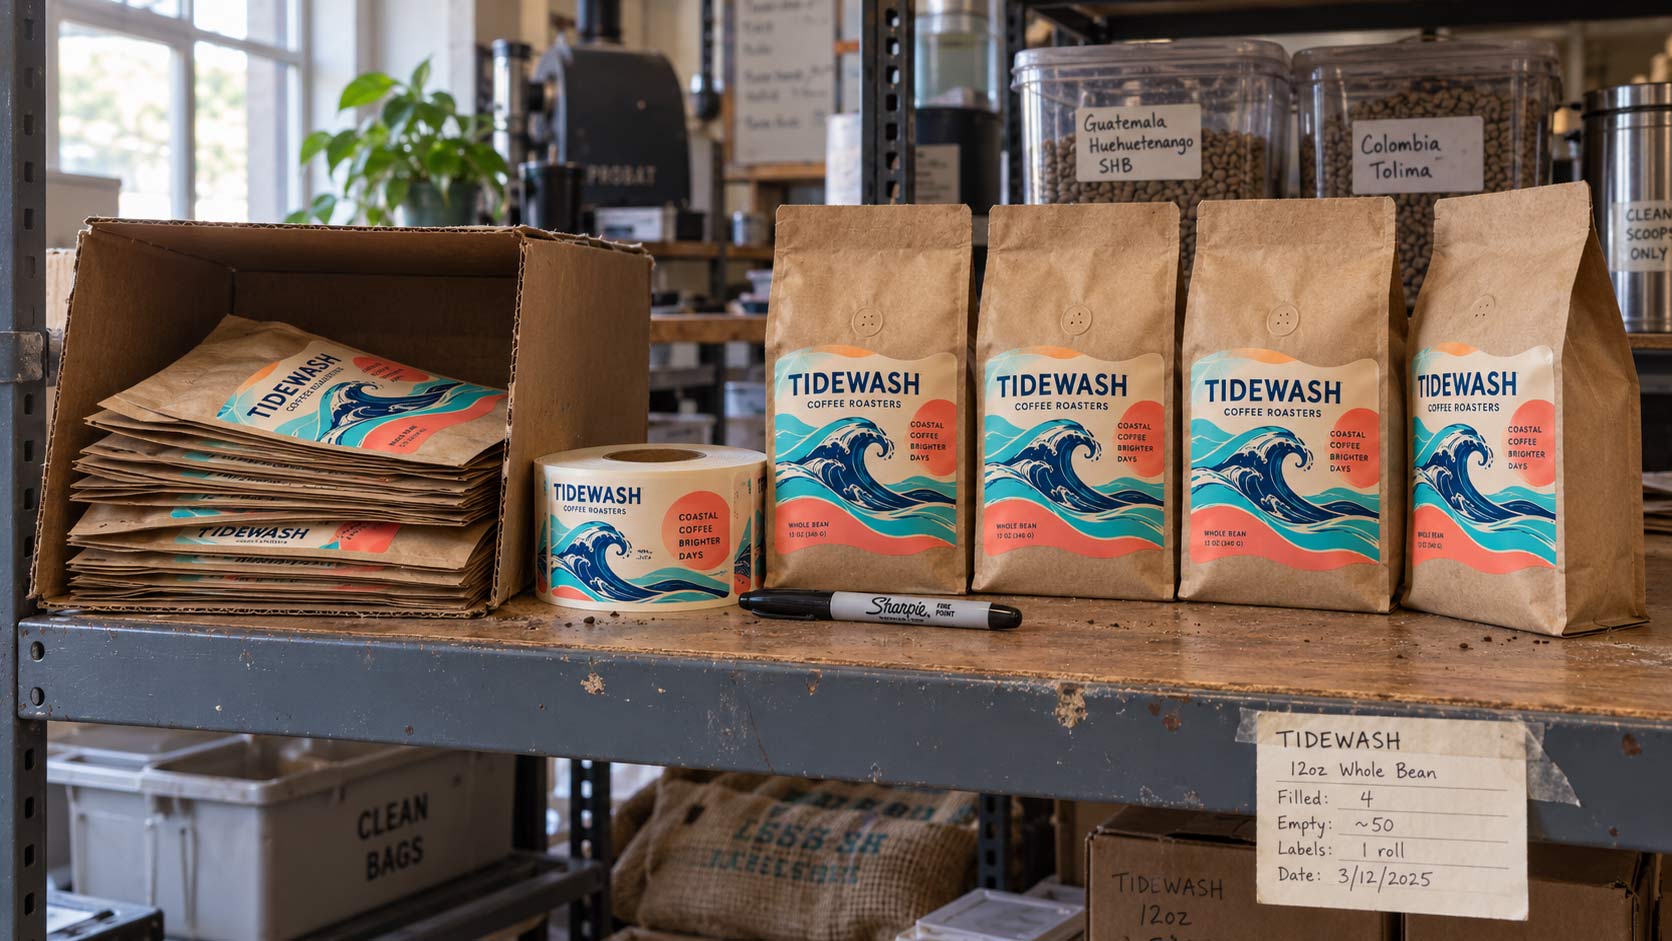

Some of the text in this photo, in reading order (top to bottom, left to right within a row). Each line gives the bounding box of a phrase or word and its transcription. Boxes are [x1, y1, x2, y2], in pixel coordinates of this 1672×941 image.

[1084, 112, 1167, 133] Guatemala
[1089, 135, 1194, 155] Huehuetenango
[1361, 133, 1441, 155] Colombia
[1099, 157, 1133, 174] SHB
[1369, 161, 1432, 180] Tolima
[1626, 208, 1672, 222] CLEAN
[1630, 246, 1668, 261] ONLY
[247, 352, 343, 419] TIDEWASH
[788, 371, 920, 396] TIDEWASH
[996, 373, 1127, 398] TIDEWASH
[1418, 371, 1517, 398] TIDEWASH
[1204, 379, 1341, 404] TIDEWASH
[807, 399, 901, 409] COFFEE ROASTERS
[1015, 402, 1109, 411] COFFEE ROASTERS
[1428, 402, 1500, 412] COFFEE ROASTERS
[1224, 407, 1322, 418] COFFEE ROASTERS
[910, 421, 944, 429] COASTAL
[1117, 422, 1152, 431] COASTAL
[1508, 425, 1542, 433] COASTAL
[910, 432, 939, 440] COFFEE
[1117, 433, 1146, 441] COFFEE
[1330, 430, 1366, 439] COASTAL
[910, 443, 946, 451] BRIGHTER
[1330, 442, 1360, 450] COFFEE
[1508, 438, 1537, 446] COFFEE
[910, 454, 930, 462] DAYS
[1330, 453, 1369, 462] BRIGHTER
[1508, 450, 1546, 459] BRIGHTER
[1330, 464, 1351, 472] DAYS
[553, 483, 641, 505] TIDEWASH
[563, 505, 627, 515] COFFEE ROASTERS
[679, 511, 718, 521] COASTAL
[197, 526, 310, 540] TIDEWASH
[679, 524, 713, 534] COFFEE
[679, 537, 721, 547] BRIGHTER
[679, 551, 703, 560] DAYS
[935, 609, 955, 617] POINT
[1275, 730, 1400, 750] TIDEWASH
[1291, 761, 1437, 779] 12oz Whole Bean
[1277, 789, 1373, 808] Filled: 4
[358, 792, 428, 839] CLEAN
[1277, 816, 1394, 839] Empty: ~50
[1278, 841, 1405, 858] Labels: 1 roll
[367, 836, 424, 881] BAGS
[1278, 864, 1433, 893] Date: 3/12/2025
[1111, 872, 1223, 900] TIDEWASH
[1140, 904, 1192, 926] 12oz
